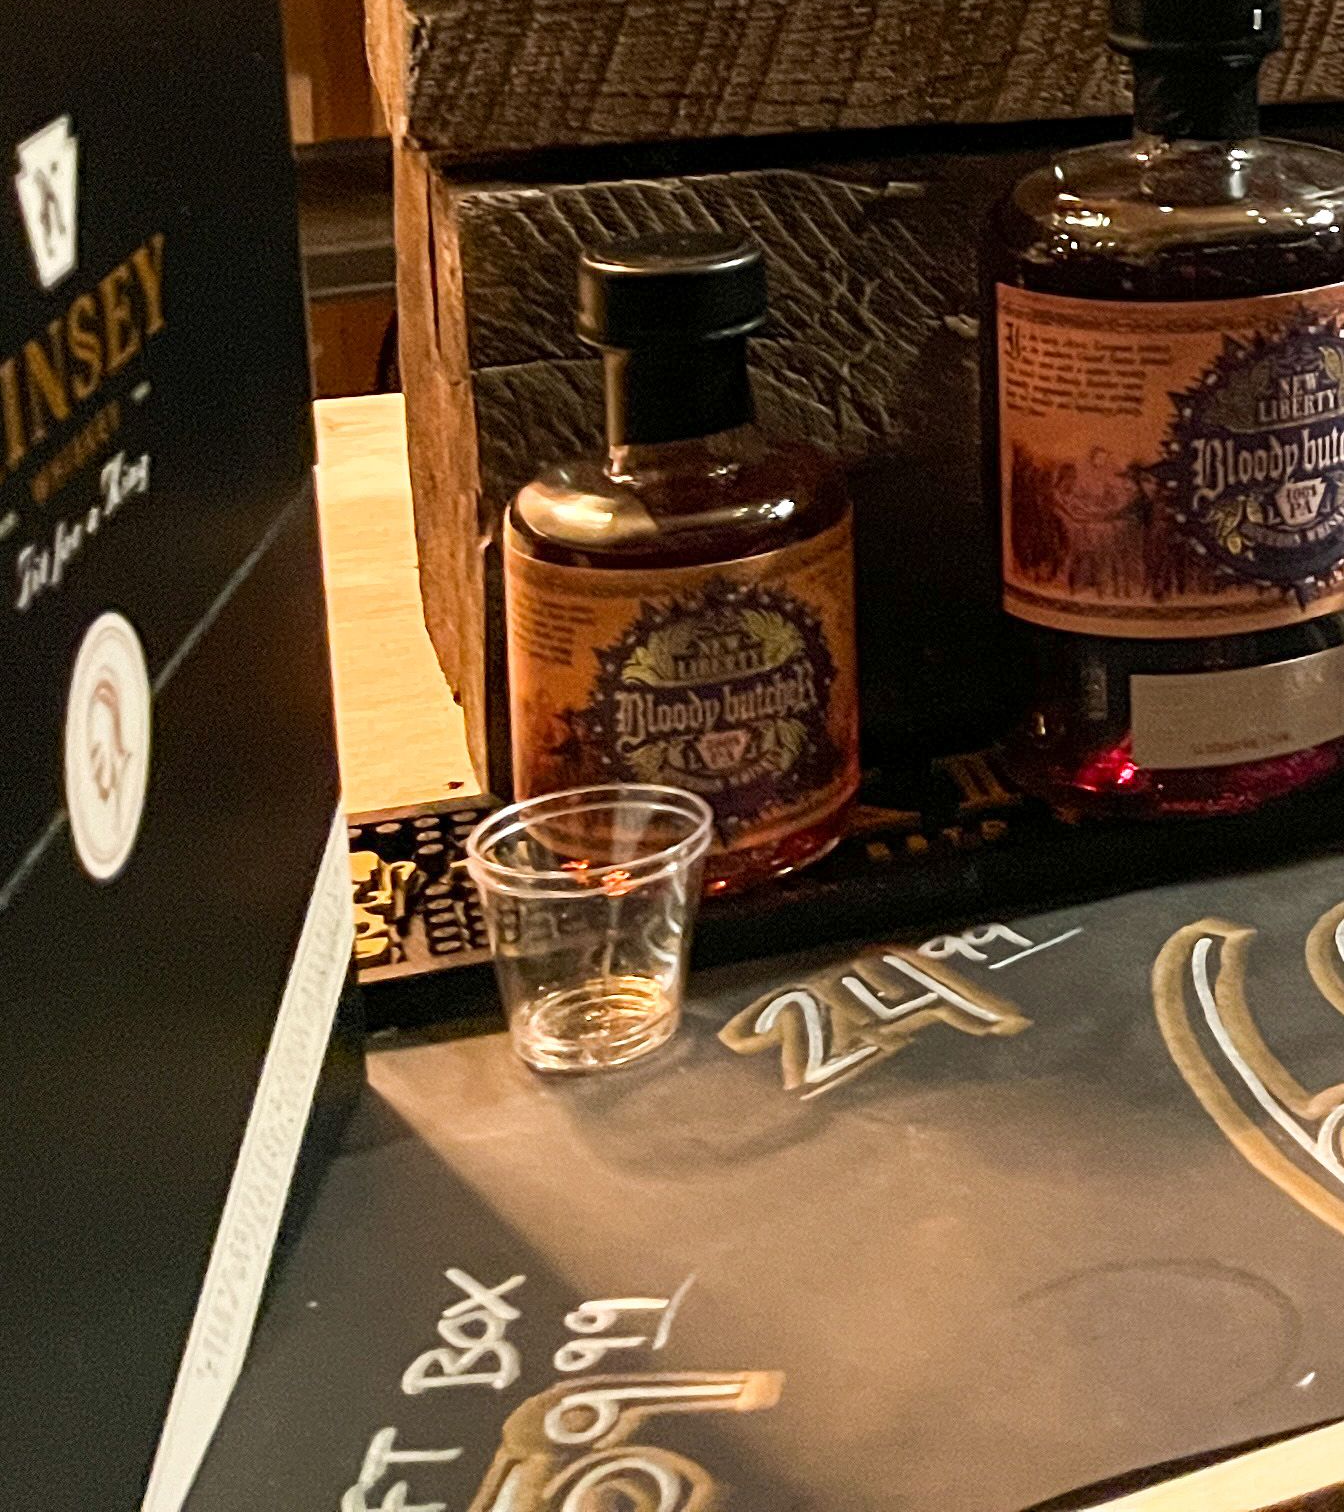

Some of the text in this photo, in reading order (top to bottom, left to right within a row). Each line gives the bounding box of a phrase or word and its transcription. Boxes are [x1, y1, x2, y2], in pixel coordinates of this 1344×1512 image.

[1257, 387, 1340, 424] LIBERTY
[1190, 435, 1303, 506] Bloody
[716, 922, 1035, 1101] 24 99
[552, 1296, 671, 1372] 99
